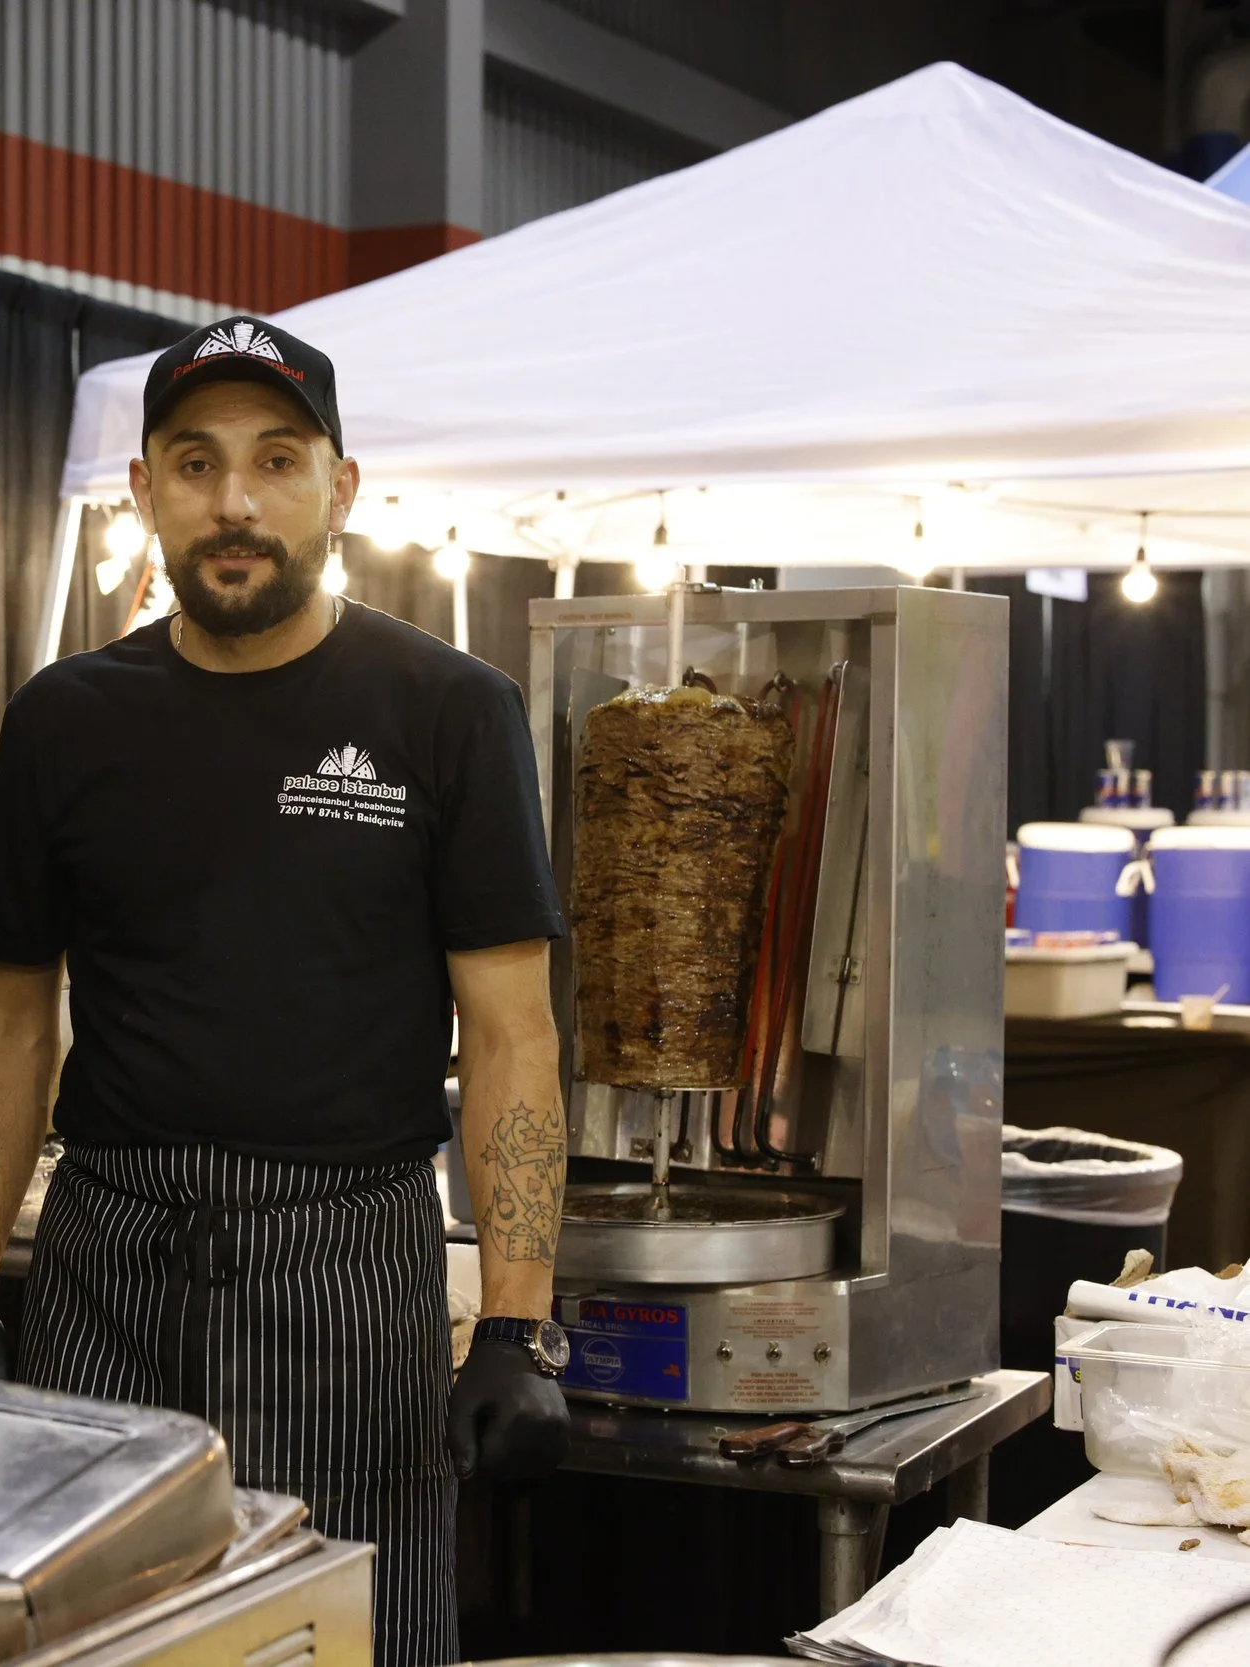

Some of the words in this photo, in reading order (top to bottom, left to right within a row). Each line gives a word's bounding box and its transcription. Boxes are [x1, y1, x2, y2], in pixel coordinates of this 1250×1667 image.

[283, 774, 340, 793] palace
[341, 778, 407, 801] istanbul
[279, 805, 304, 816] 7207
[306, 806, 315, 816] W
[613, 1305, 679, 1324] GYROS
[585, 1354, 620, 1366] OLYMPIA
